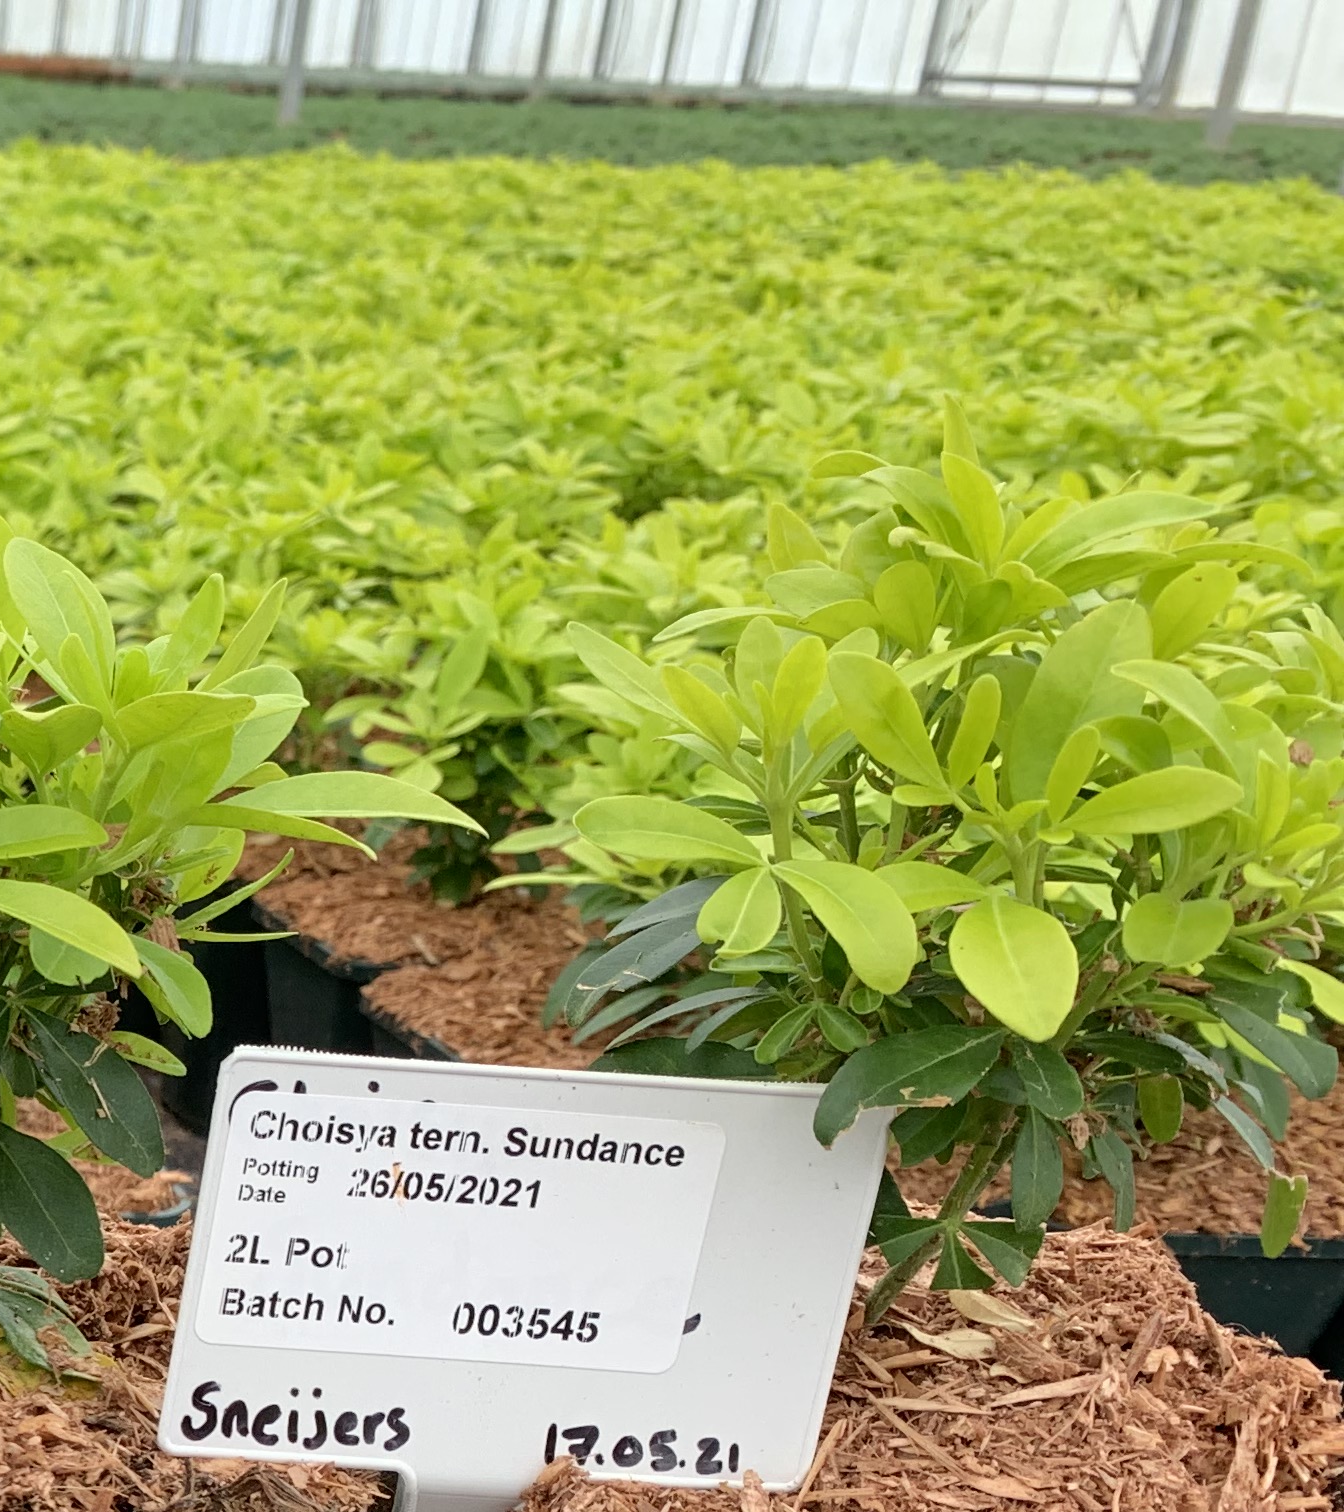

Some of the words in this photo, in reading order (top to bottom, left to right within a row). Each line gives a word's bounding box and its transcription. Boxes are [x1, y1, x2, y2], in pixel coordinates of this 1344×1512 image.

[250, 1110, 397, 1153] Choisya
[410, 1121, 489, 1154] tern.
[503, 1126, 685, 1168] Sundance
[238, 1184, 286, 1204] Date
[242, 1157, 320, 1184] Potting
[346, 1167, 541, 1209] 26/05/2021
[224, 1234, 270, 1265] 2L
[285, 1237, 350, 1270] Pot
[219, 1287, 325, 1321] Batch
[337, 1294, 395, 1326] No.
[452, 1302, 601, 1343] 003545
[180, 1380, 411, 1452] Sneijers
[543, 1422, 740, 1475] 17.05.21
